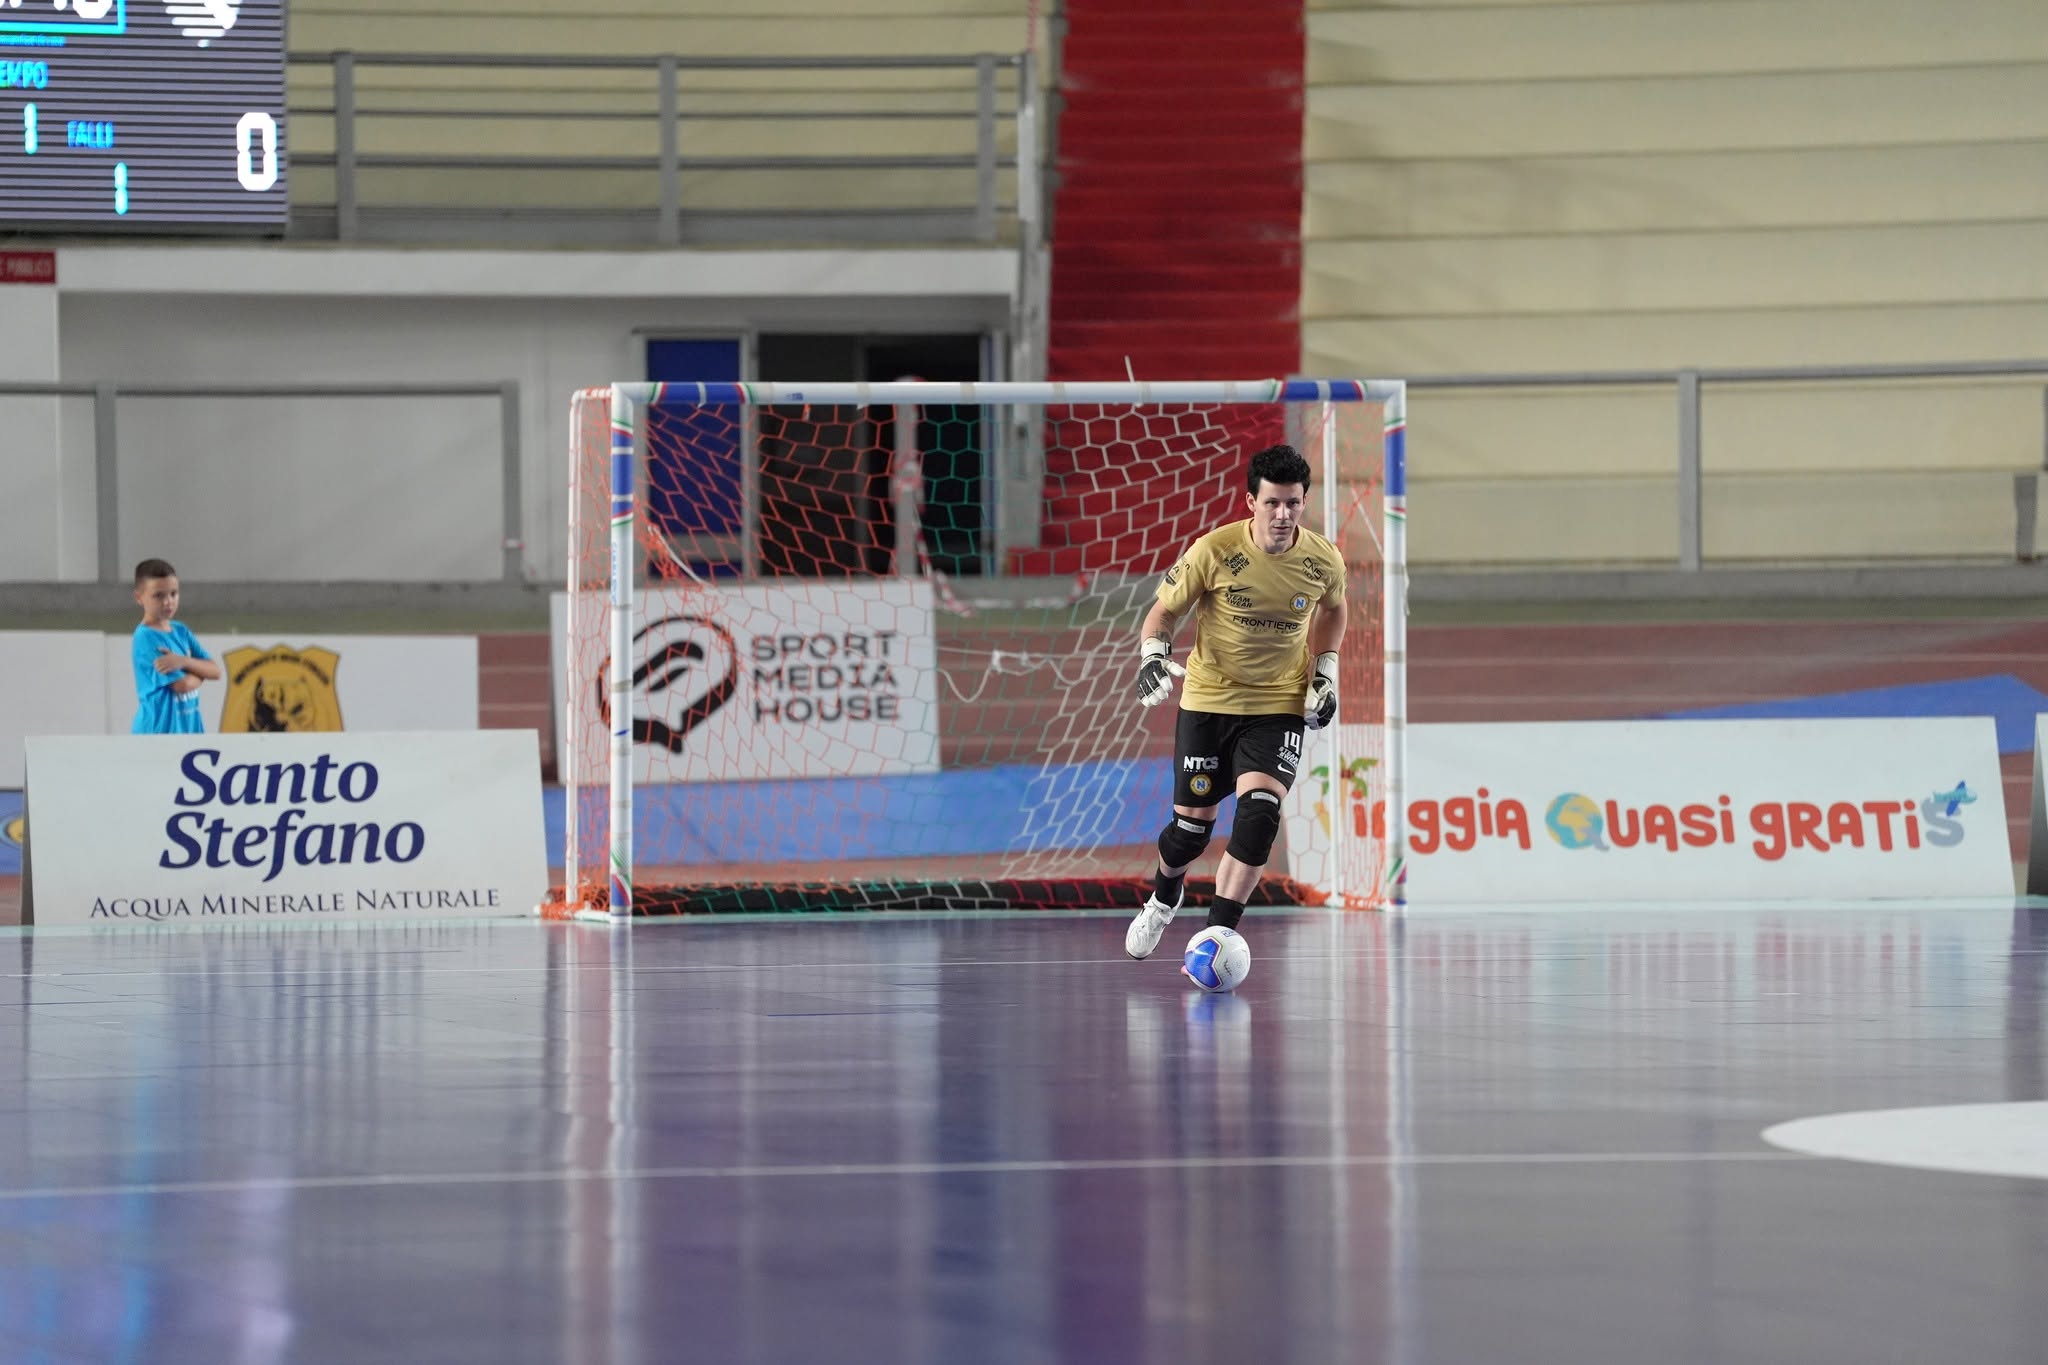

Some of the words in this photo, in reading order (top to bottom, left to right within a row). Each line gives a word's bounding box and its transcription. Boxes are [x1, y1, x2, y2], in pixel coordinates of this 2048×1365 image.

[67, 120, 114, 148] FALLI
[236, 112, 278, 191] 0
[1232, 615, 1298, 630] FRONTIERS
[752, 630, 896, 661] SPORT
[753, 662, 897, 691] MEDIA
[755, 694, 899, 722] HOUSE
[1183, 755, 1219, 770] NTCS
[174, 749, 379, 807] Santo
[159, 809, 425, 883] Stefano
